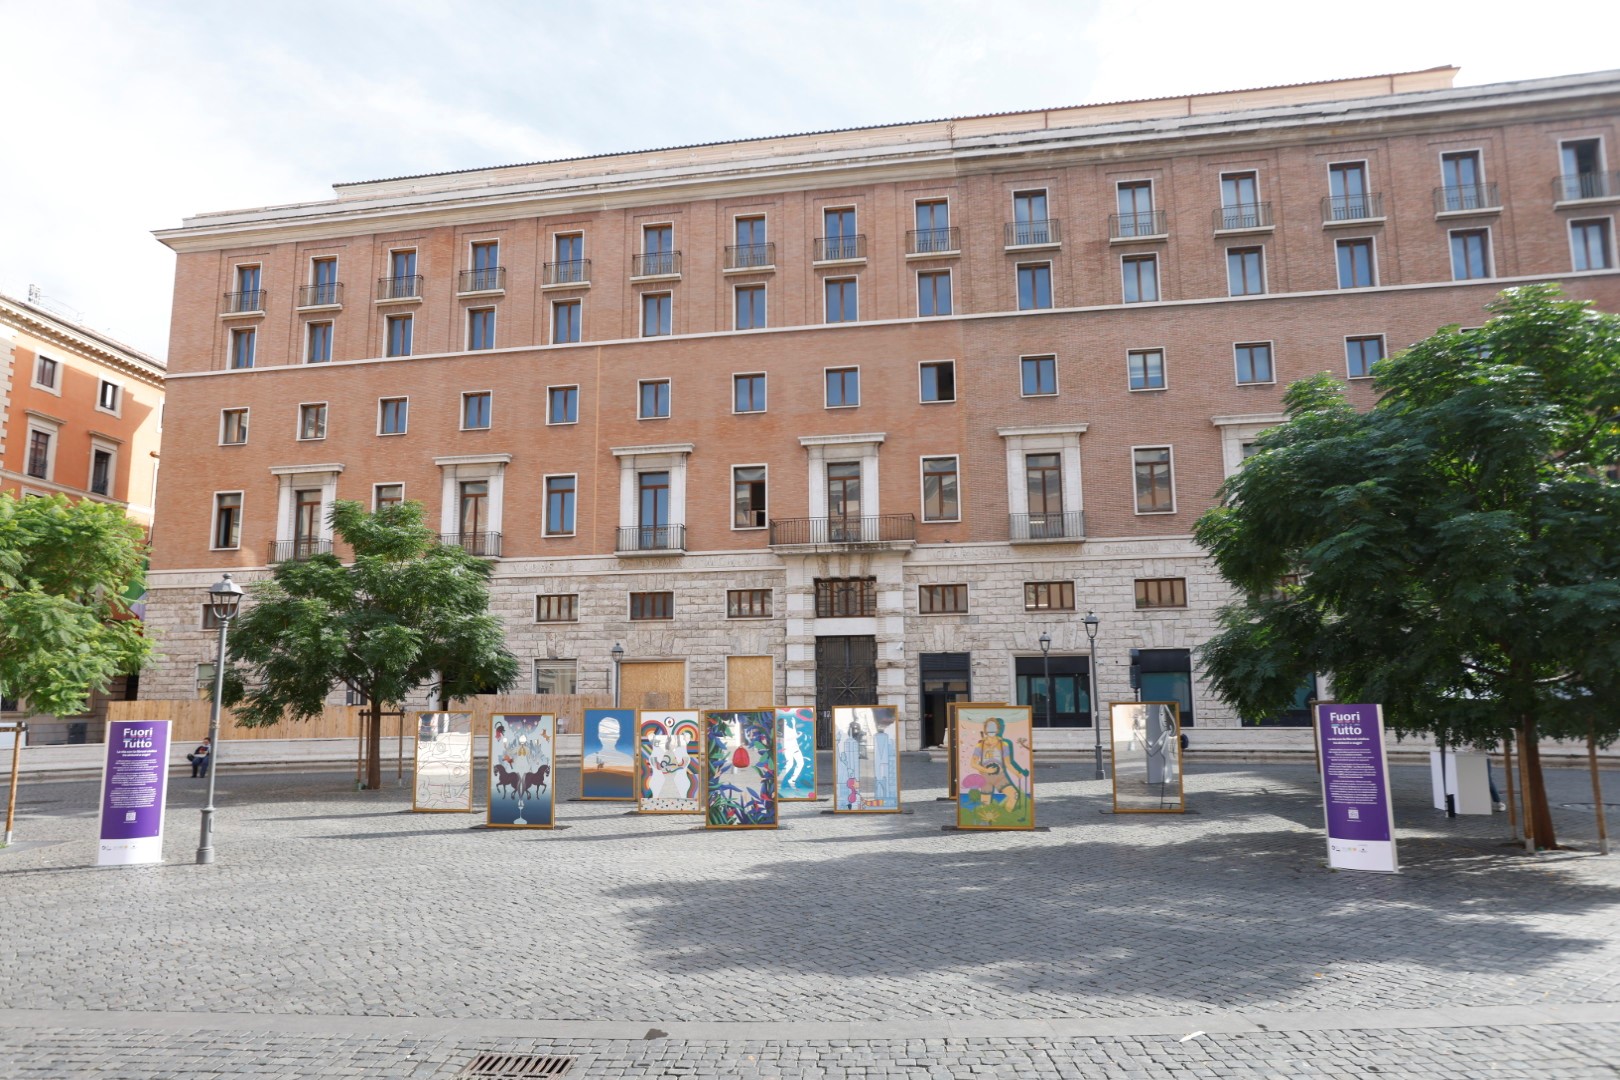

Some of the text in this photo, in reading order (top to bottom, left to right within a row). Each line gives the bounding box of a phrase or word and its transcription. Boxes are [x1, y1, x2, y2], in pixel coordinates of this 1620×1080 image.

[1330, 711, 1360, 721] Fuori
[123, 727, 153, 736] Fuori
[1331, 725, 1362, 735] Tutto
[122, 739, 152, 748] Tutto
